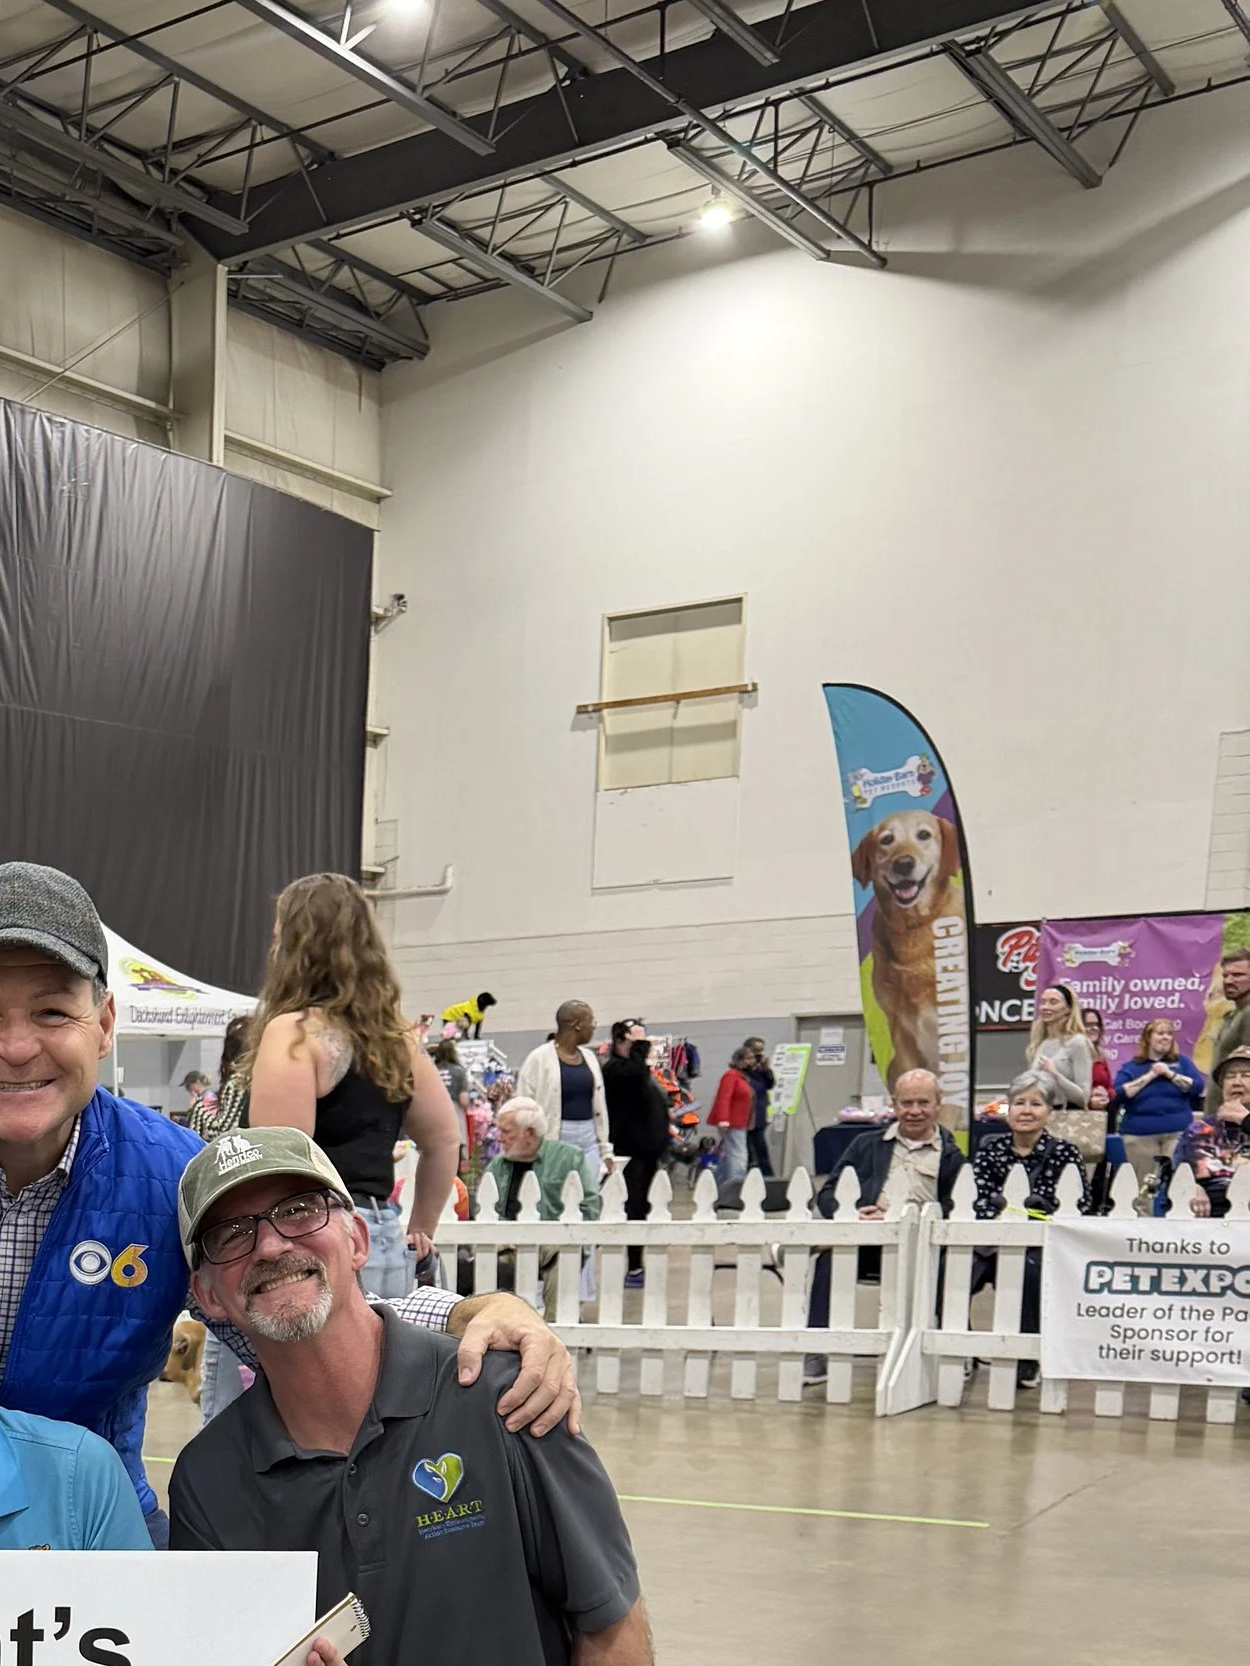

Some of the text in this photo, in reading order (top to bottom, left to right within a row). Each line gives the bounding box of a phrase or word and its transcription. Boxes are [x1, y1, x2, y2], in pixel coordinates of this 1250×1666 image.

[1129, 976, 1205, 991] owned,
[1123, 993, 1185, 1009] loved.
[130, 1005, 172, 1024] Dachshund
[932, 916, 970, 1108] CREATING JOY
[219, 1149, 260, 1171] Henrico
[1126, 1237, 1231, 1255] Thanks to
[1076, 1303, 1250, 1322] Leader of the Pa
[1110, 1324, 1234, 1343] Sponsor for
[1098, 1344, 1242, 1368] their support!
